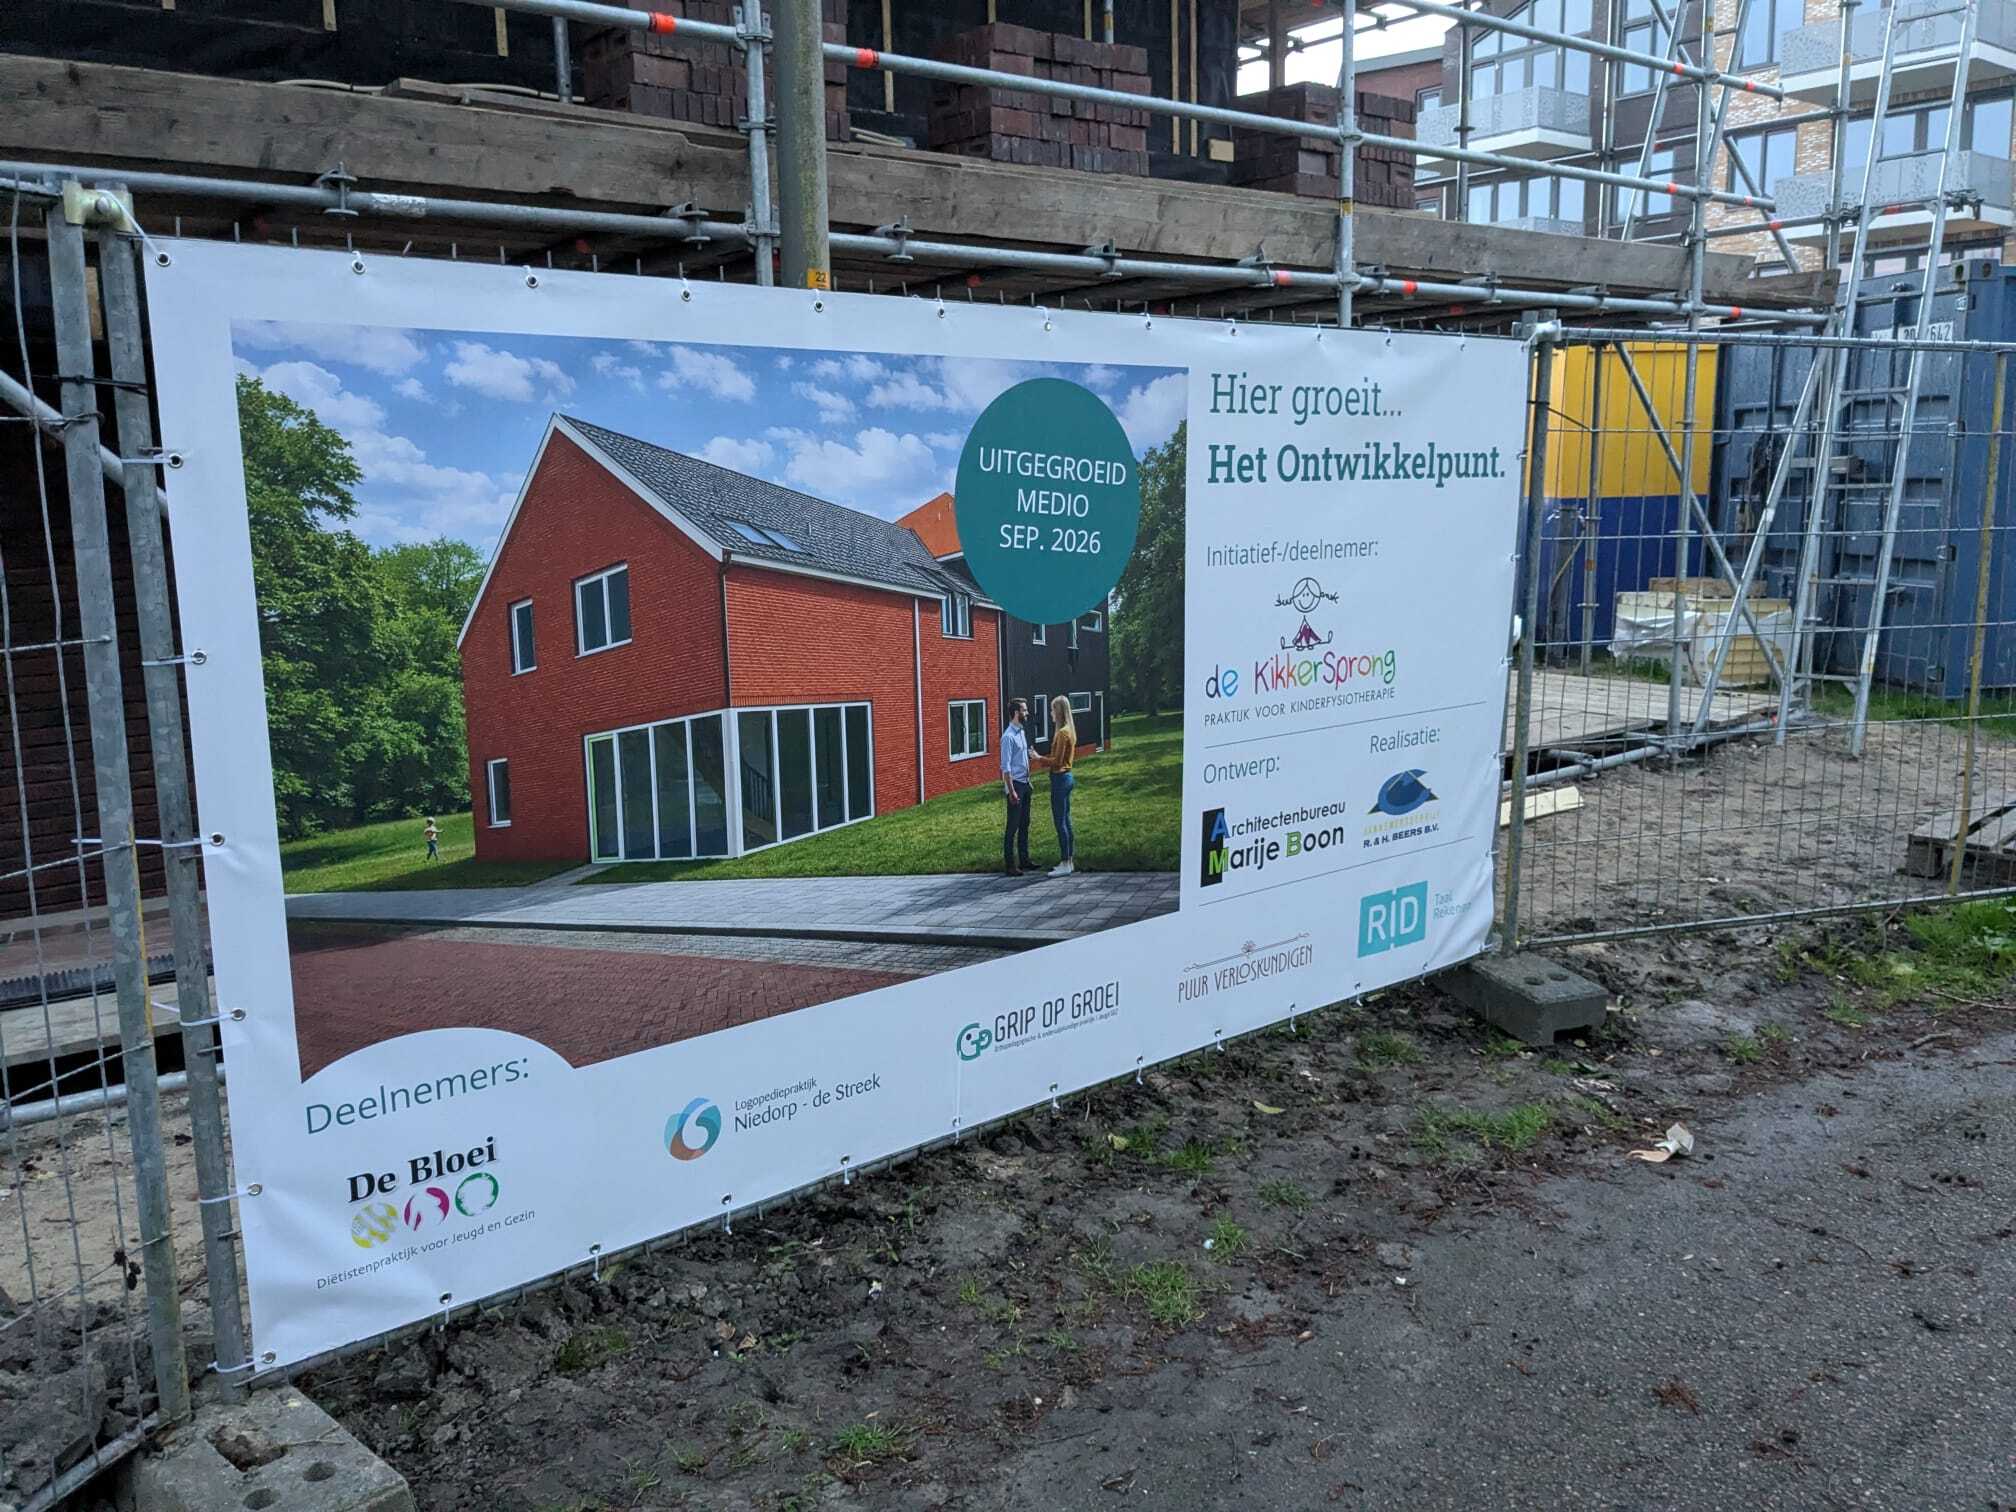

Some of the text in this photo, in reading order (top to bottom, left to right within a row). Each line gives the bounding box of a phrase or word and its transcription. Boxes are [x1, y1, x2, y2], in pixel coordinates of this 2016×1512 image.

[1209, 372, 1402, 425] Hier groeit...
[979, 447, 1127, 486] UITGEGROEID
[1207, 441, 1505, 488] Het Ontwikkelpunt.
[1017, 488, 1089, 518] MEDIO
[999, 523, 1101, 554] SEP. 2026
[1206, 538, 1379, 567] Initiatief-/deelnemer:
[1205, 649, 1396, 699] de KikkerSprong
[1203, 686, 1396, 728] PRAKTIJK VOOR KINDERFYSIOTHERAPIE
[1369, 727, 1441, 754] Realisatie:
[1203, 756, 1280, 784] Ontwerp:
[1210, 800, 1346, 842] Architectenbureau
[1392, 826, 1423, 841] BEERS
[1424, 823, 1440, 834] B.V.
[1208, 826, 1344, 876] Marije Boon
[1367, 896, 1418, 945] RID
[1177, 943, 1313, 1003] PUUR VERLOSKUNDIGEN
[994, 1006, 1036, 1042] GRIP
[1042, 998, 1065, 1028] OP
[1071, 980, 1119, 1019] GROEI
[305, 1057, 529, 1134] Deelnemers:
[734, 1100, 798, 1133] Niedorp
[812, 1090, 831, 1108] de
[834, 1072, 881, 1101] Streek
[735, 1076, 818, 1111] Logopediepraktijk
[347, 1136, 497, 1203] De Bloei
[316, 1209, 536, 1290] Diëtistenpraktijk voor Jeugd en Gezin
